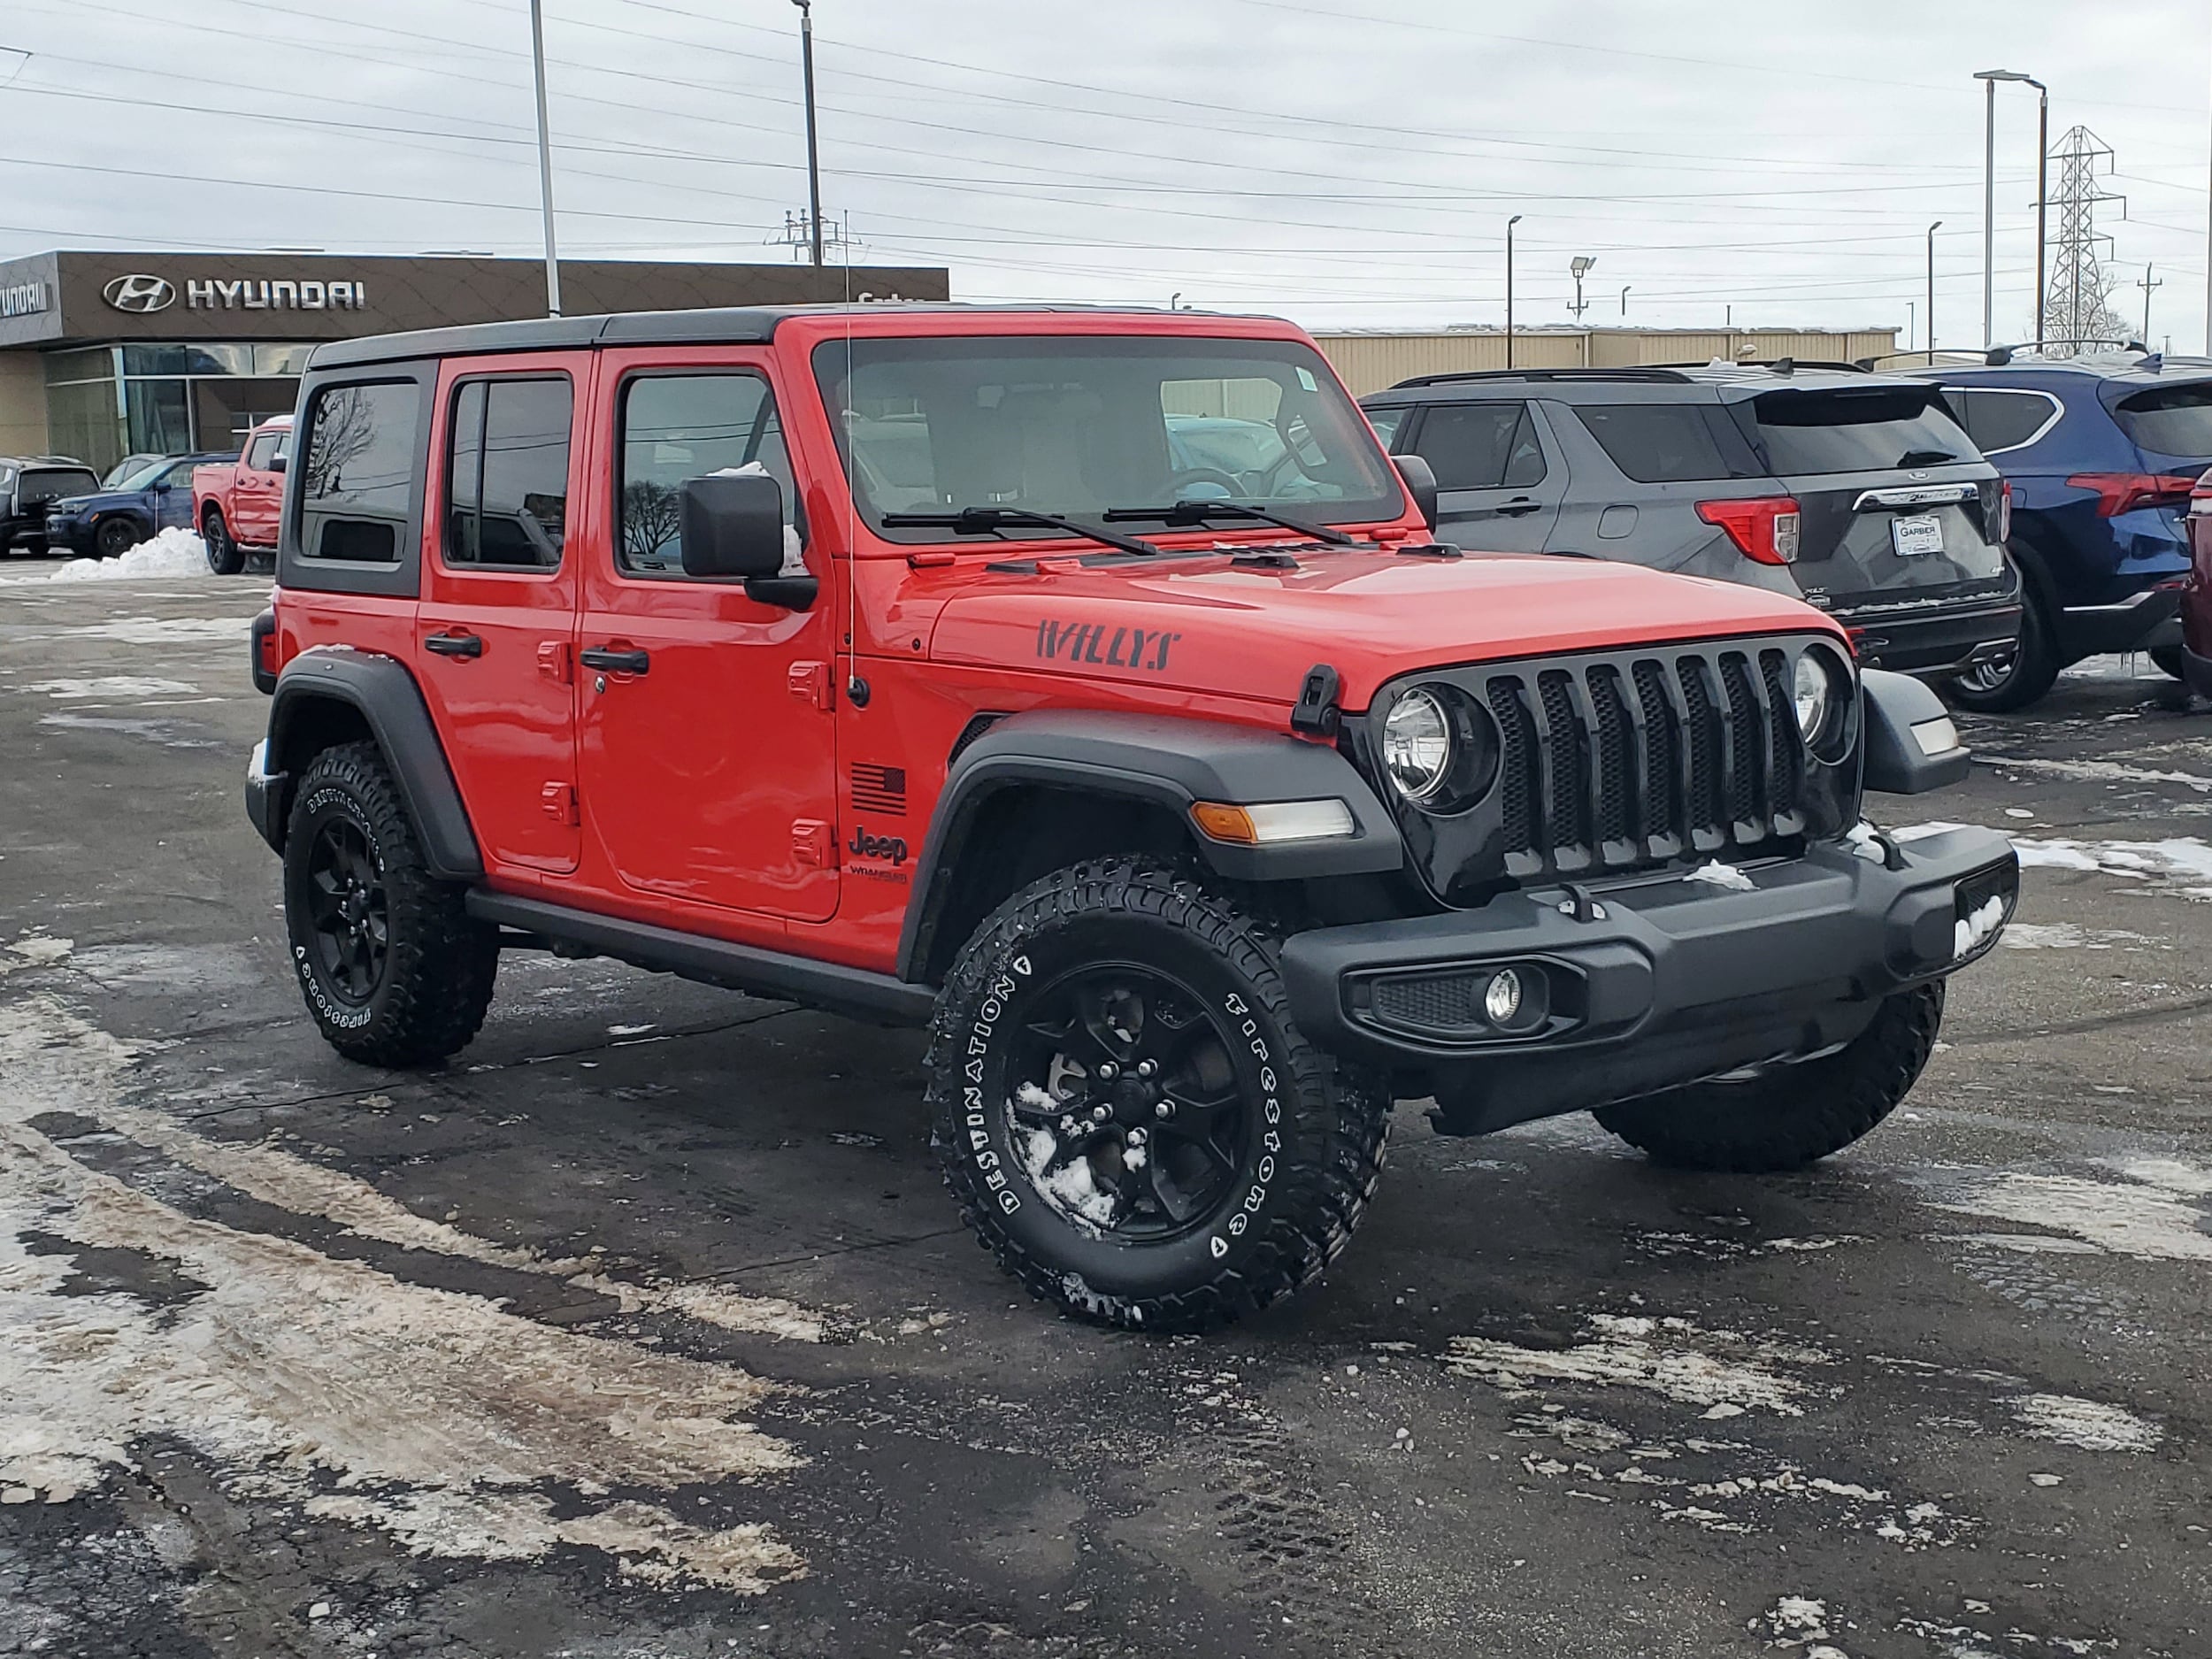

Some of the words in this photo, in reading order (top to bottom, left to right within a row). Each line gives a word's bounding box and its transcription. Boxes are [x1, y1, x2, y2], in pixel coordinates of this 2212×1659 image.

[0, 283, 47, 317] UNDAI
[187, 279, 366, 310] HYUNDAI
[1900, 526, 1936, 537] GARBER
[1037, 619, 1182, 671] WILLYS
[849, 825, 908, 867] Jeep
[849, 865, 907, 883] WRAN
[964, 974, 1021, 1216] DESTINATION
